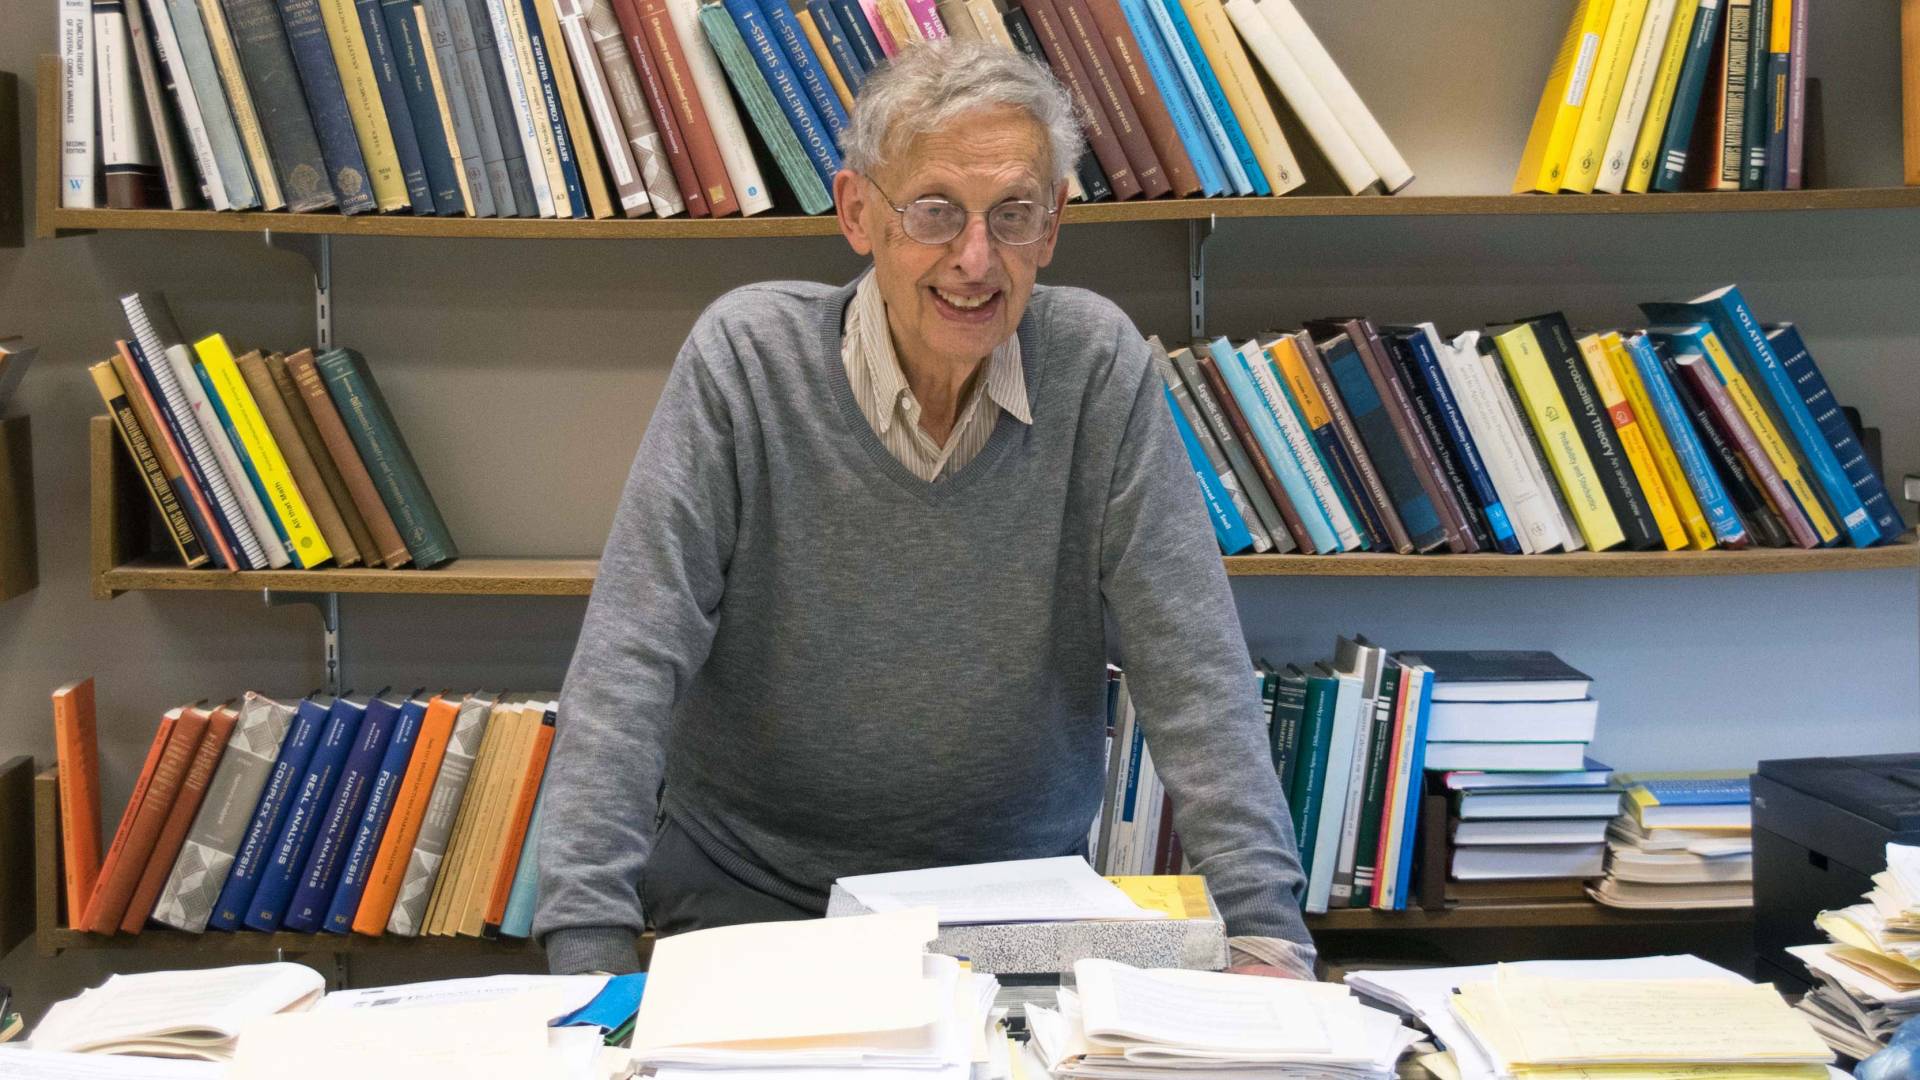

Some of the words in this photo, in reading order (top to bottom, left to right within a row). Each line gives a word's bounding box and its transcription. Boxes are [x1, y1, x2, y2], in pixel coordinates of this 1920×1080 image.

[1066, 6, 1087, 38] HARMONIC
[531, 34, 548, 79] VARIABLES
[1051, 41, 1071, 71] ANALYSIS
[1082, 39, 1101, 69] ANALYSIS
[1097, 68, 1105, 77] IN
[1729, 75, 1745, 83] LA
[543, 83, 558, 121] COMPLEX
[802, 67, 845, 136] NOMETRIC
[1100, 76, 1122, 110] EUCLIDEAN
[773, 69, 838, 178] TRIGONOMETRIC
[1116, 110, 1132, 134] SPACES
[553, 124, 568, 162] SEVERAL
[69, 178, 82, 192] W
[1734, 303, 1777, 371] VOLATILITY
[1319, 382, 1338, 410] MARKOV
[1427, 365, 1449, 402] Convergence
[1195, 383, 1219, 415] Ergodic
[1211, 413, 1233, 442] theory
[1414, 395, 1428, 414] Louis
[1445, 402, 1453, 410] of
[1564, 357, 1596, 418] Probability
[1589, 416, 1614, 458] Theory
[1730, 378, 1754, 411] Probability
[1751, 410, 1768, 433] Theory
[1249, 364, 1283, 420] STATIONARY
[1279, 423, 1307, 467] RANDOM
[1303, 468, 1335, 520] FUNCTIONS
[1447, 410, 1467, 443] Probability
[1463, 442, 1480, 470] Measures
[1559, 431, 1577, 465] Probability
[1573, 464, 1583, 477] and
[1697, 410, 1724, 447] Financial
[1719, 446, 1745, 481] Calculus
[142, 456, 159, 472] DES
[1299, 436, 1323, 474] THEORY
[1319, 475, 1330, 489] OF
[1439, 451, 1457, 476] Theory
[1609, 456, 1620, 468] An
[272, 479, 288, 501] Math
[1360, 461, 1387, 508] MARTINGALES
[1452, 474, 1461, 484] of
[1613, 468, 1633, 499] analytic
[160, 492, 175, 504] LA
[165, 500, 179, 513] DE
[282, 500, 296, 518] that
[1195, 470, 1216, 501] Grinstead
[1212, 500, 1223, 514] and
[1219, 513, 1232, 529] Snell
[1455, 483, 1481, 524] Speculation
[1628, 497, 1641, 516] view
[1712, 506, 1725, 517] W
[290, 517, 302, 529] All
[1316, 690, 1325, 715] Operators
[1285, 720, 1295, 749] BENNETT
[1312, 716, 1321, 746] Differential
[1309, 750, 1317, 767] Spaces
[258, 760, 287, 819] COMPLEX
[299, 773, 318, 805] REAL
[365, 769, 390, 822] FOURIER
[1306, 768, 1314, 791] Function
[328, 769, 357, 835] FUNCTIONAL
[1303, 795, 1311, 812] Theory
[276, 806, 305, 865] ANALYSIS
[1299, 815, 1309, 847] Interpolation
[234, 819, 264, 878] ANALYSIS
[308, 836, 332, 888] ANALYSIS
[344, 825, 371, 885] ANALYSIS
